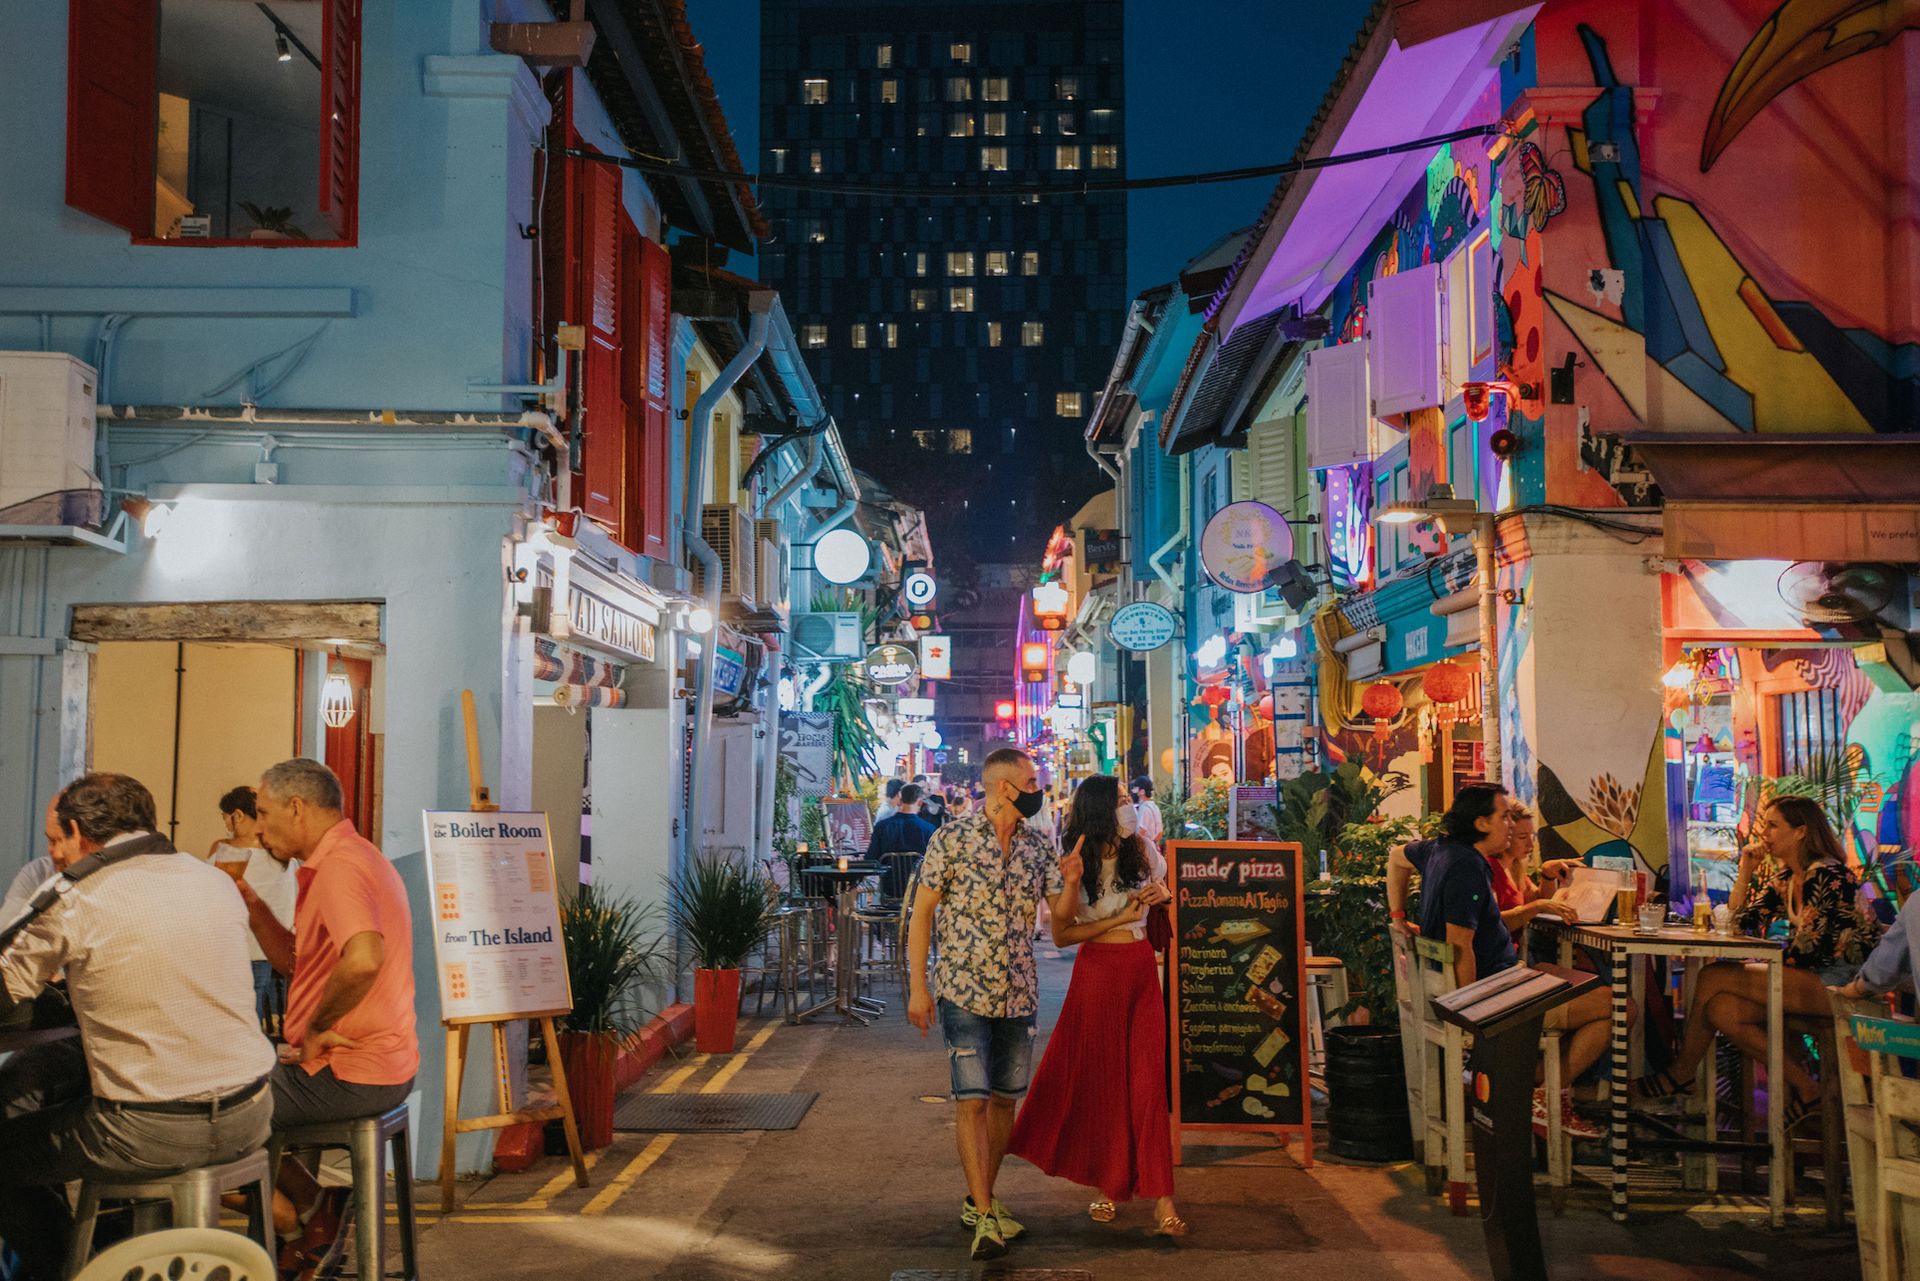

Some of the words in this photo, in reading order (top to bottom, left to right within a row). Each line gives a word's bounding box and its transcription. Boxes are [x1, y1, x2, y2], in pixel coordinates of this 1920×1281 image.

[601, 604, 655, 659] SAILORS
[449, 822, 495, 838] Boiler
[498, 822, 542, 839] Room
[1239, 858, 1286, 885] pizza
[444, 932, 467, 944] from
[469, 929, 501, 946] The
[503, 926, 553, 945] Island
[1180, 946, 1228, 959] Marinara
[1180, 962, 1234, 981] Margherita
[1182, 980, 1215, 994] Salami
